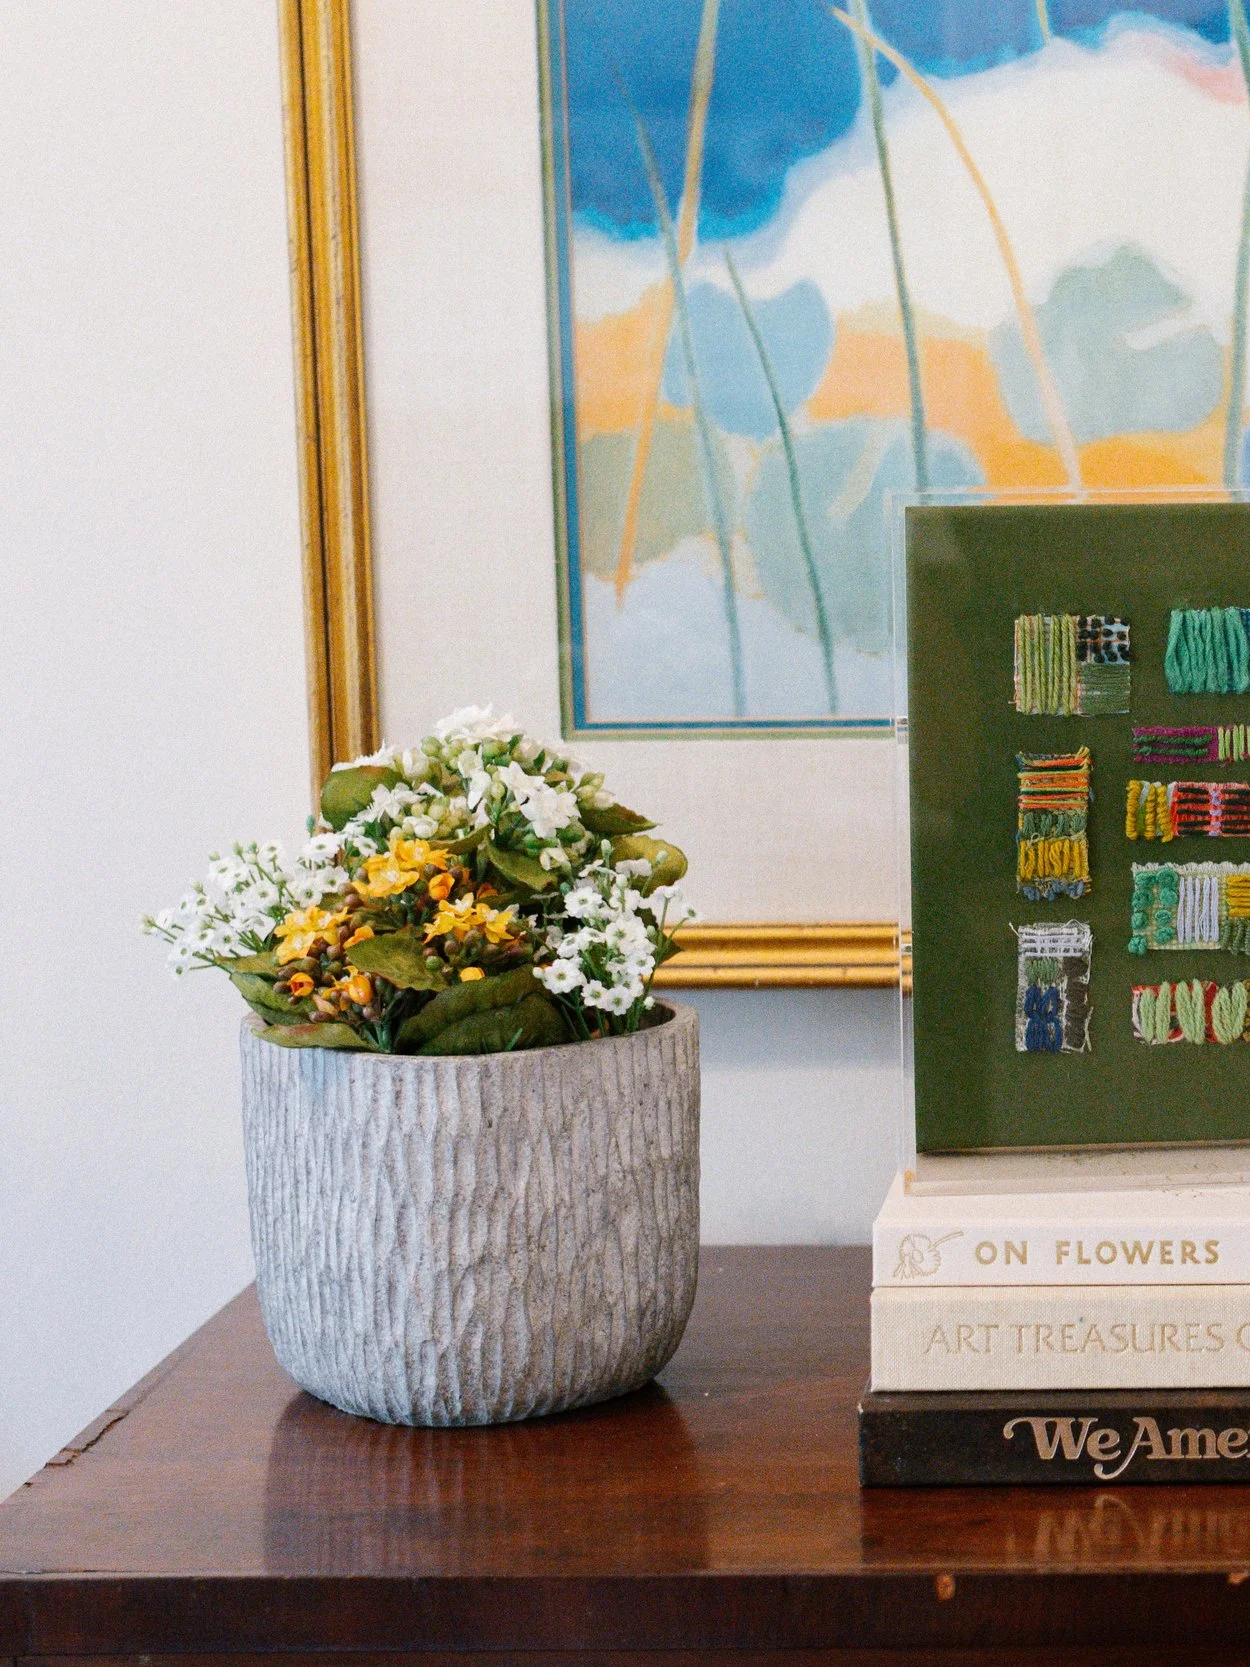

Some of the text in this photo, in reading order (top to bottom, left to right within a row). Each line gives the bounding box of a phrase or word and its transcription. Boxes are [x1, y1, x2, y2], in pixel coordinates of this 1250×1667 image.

[974, 1240, 1220, 1266] ON FLOWERS
[924, 1323, 1000, 1355] ART
[1008, 1322, 1225, 1354] TREASURES
[1003, 1416, 1121, 1461] We
